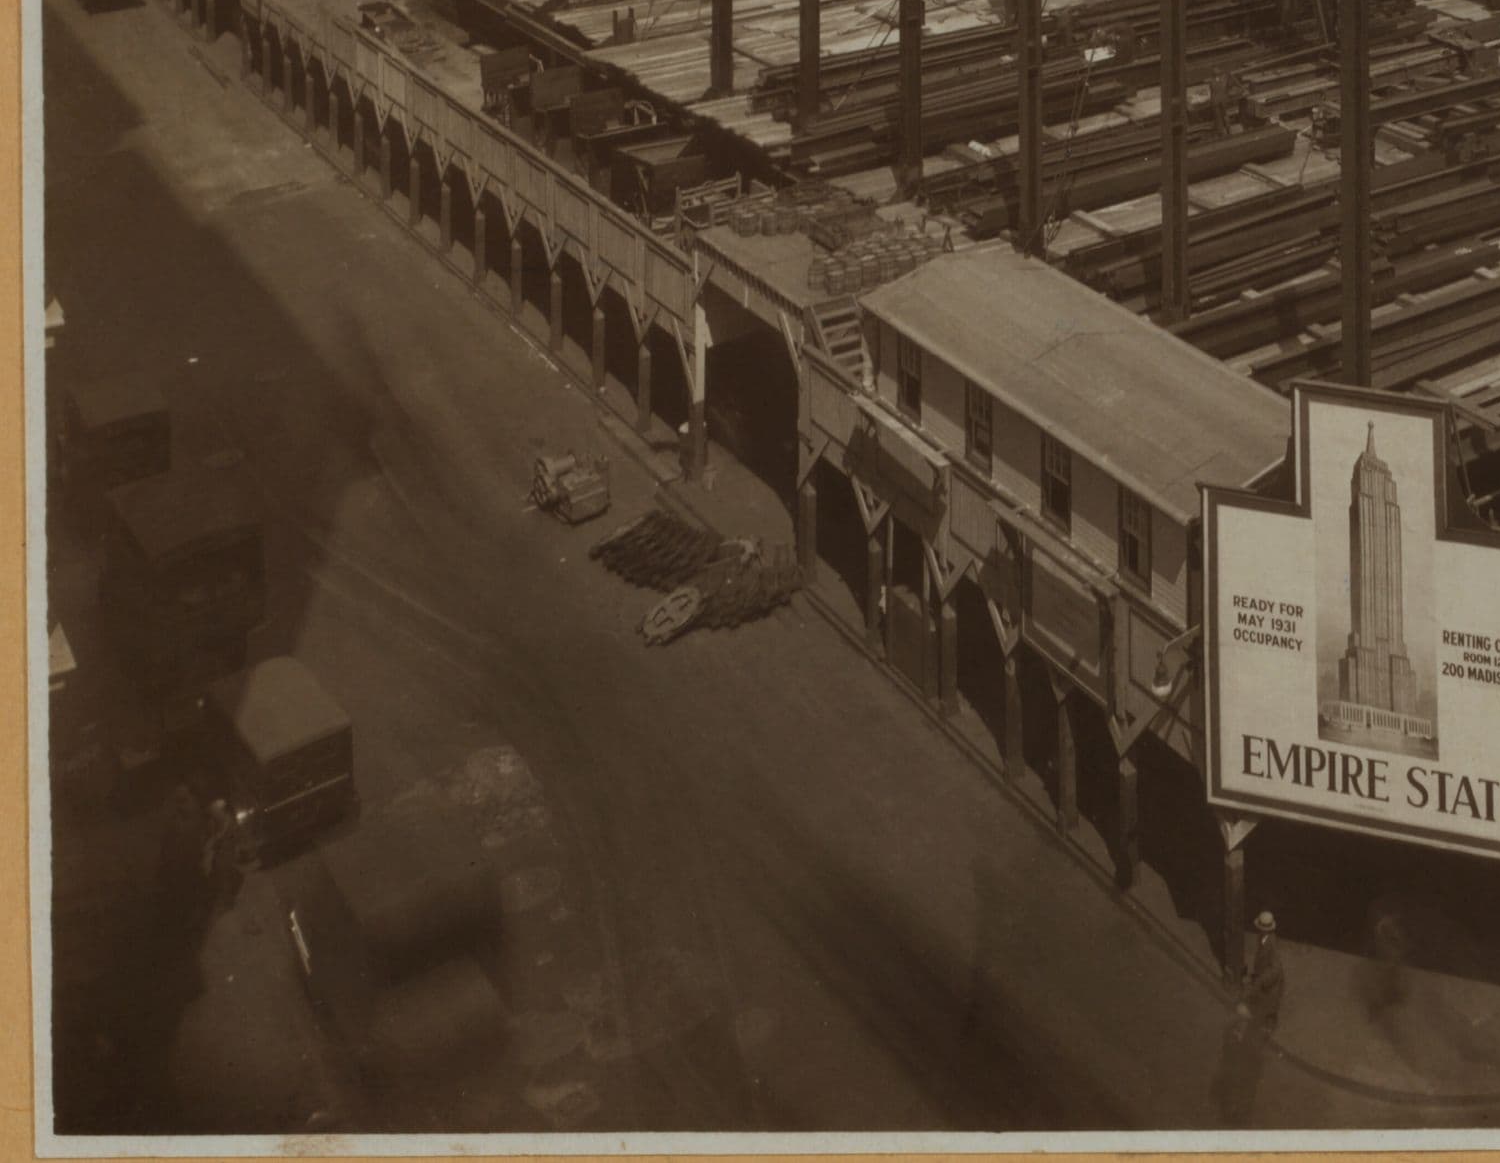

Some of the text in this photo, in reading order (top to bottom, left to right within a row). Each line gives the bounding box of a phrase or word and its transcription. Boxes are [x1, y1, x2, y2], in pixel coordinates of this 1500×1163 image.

[1233, 595, 1305, 618] READY FOR
[1237, 612, 1297, 634] MAY 1931
[1233, 628, 1303, 652] OCCUPANCY
[1442, 630, 1492, 653] RENTING
[1463, 651, 1492, 666] ROOM
[1442, 662, 1465, 679] 200
[1241, 734, 1390, 802] EMPIRE
